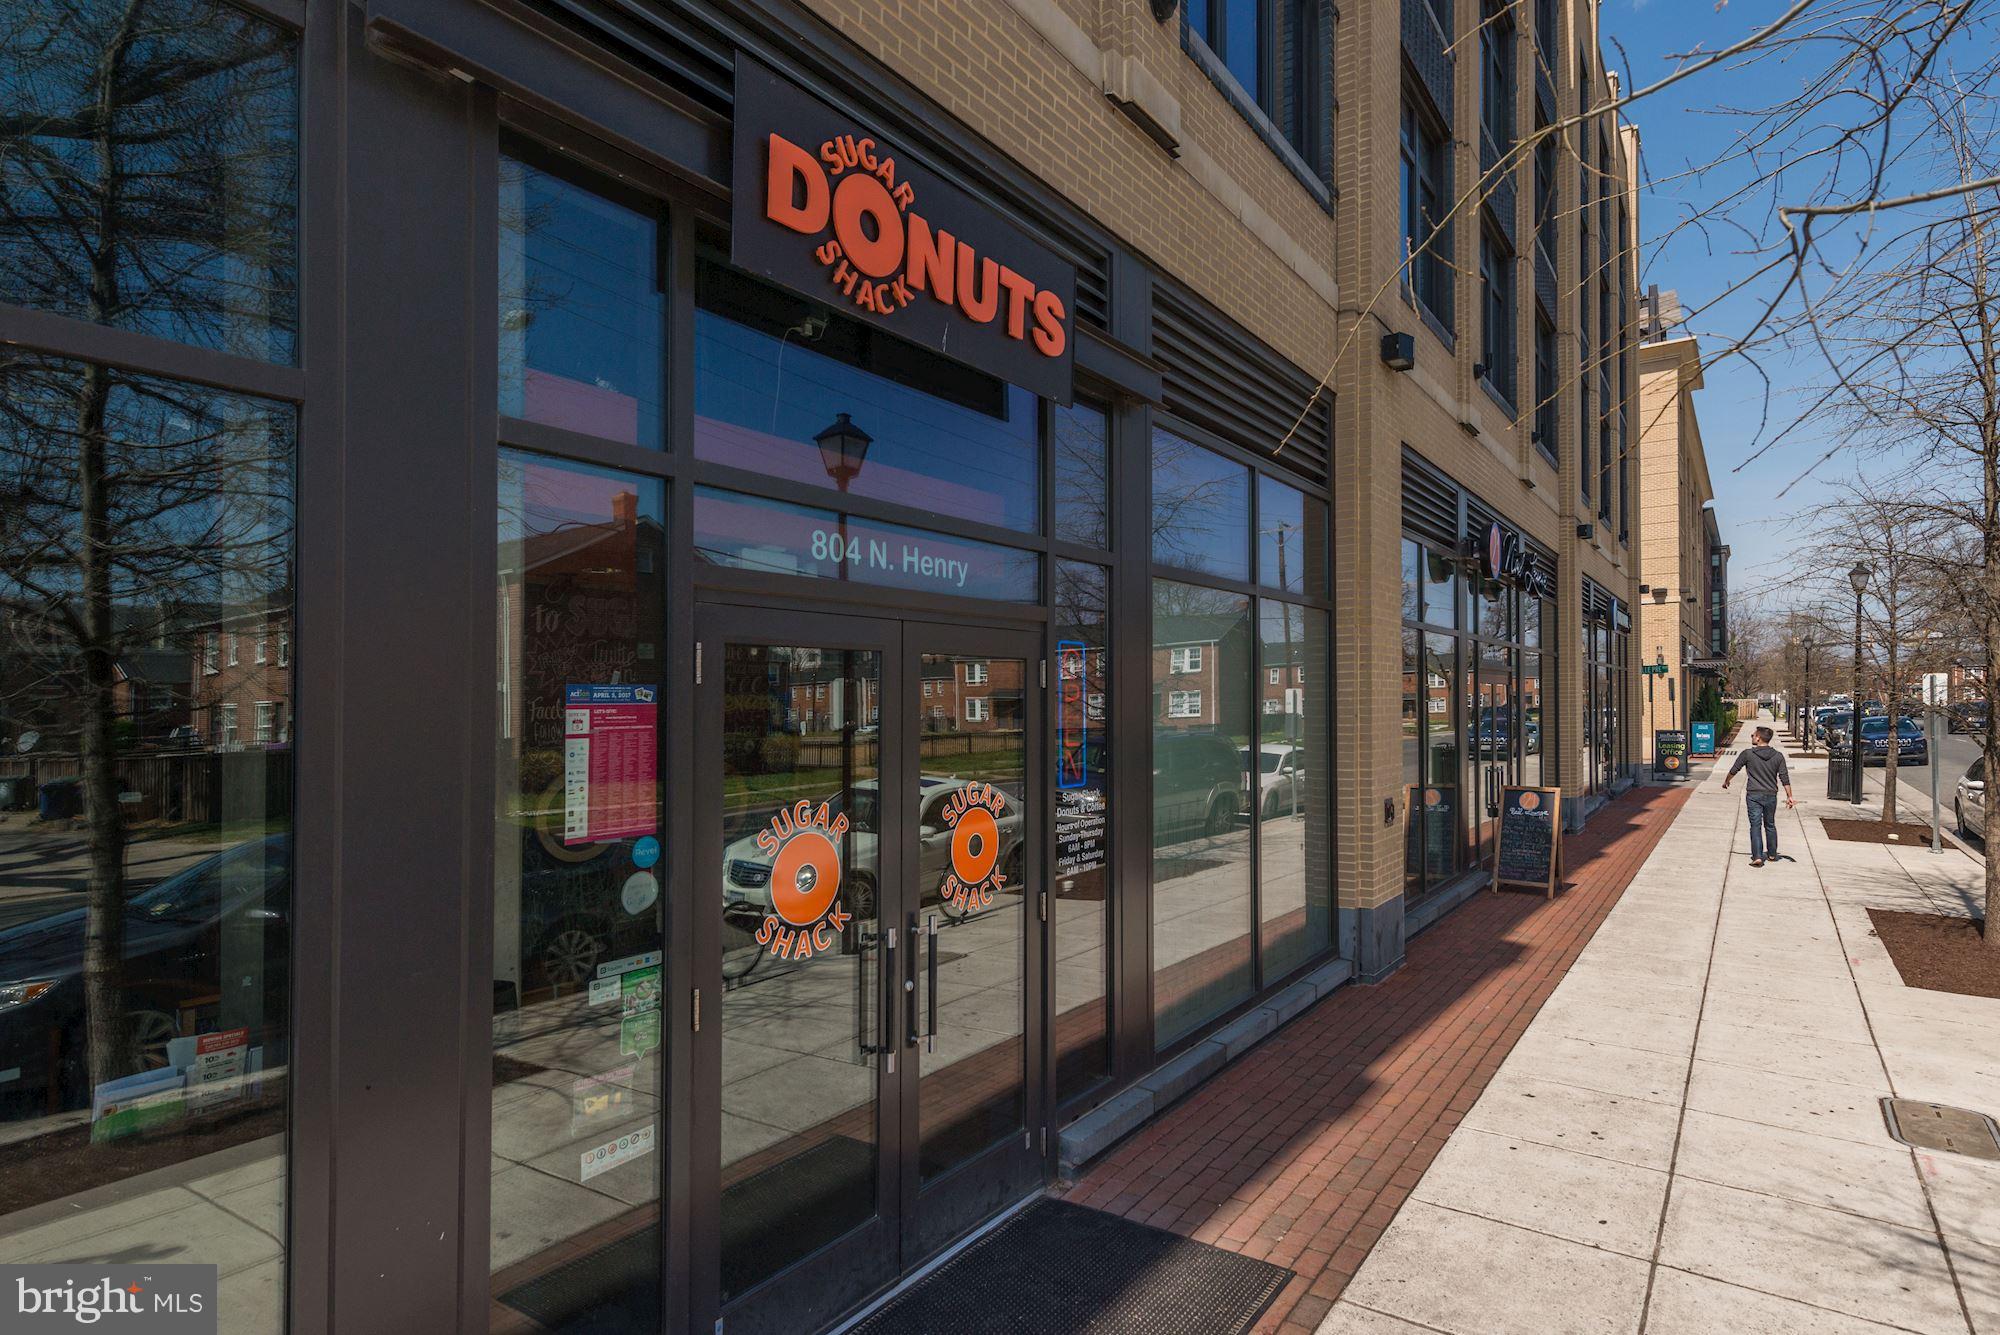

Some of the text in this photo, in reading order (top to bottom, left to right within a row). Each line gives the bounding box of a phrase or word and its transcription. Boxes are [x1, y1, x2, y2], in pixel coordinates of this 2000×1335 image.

[820, 134, 915, 211] SUGAR
[767, 132, 1066, 358] DONUTS
[816, 239, 916, 315] SHACK
[811, 529, 968, 587] 804 N. Henry
[1062, 648, 1082, 781] OPEN
[1658, 743, 1686, 751] Leasing
[756, 800, 850, 857] SUGAR
[942, 781, 1005, 827] SUGAR
[1057, 805, 1079, 817] Donuts
[1086, 802, 1106, 812] Coffee
[1080, 816, 1105, 828] Operation
[1058, 855, 1076, 867] Friday
[1081, 849, 1104, 862] Saturday
[941, 865, 1007, 912] SHACK
[755, 901, 852, 960] SHACK
